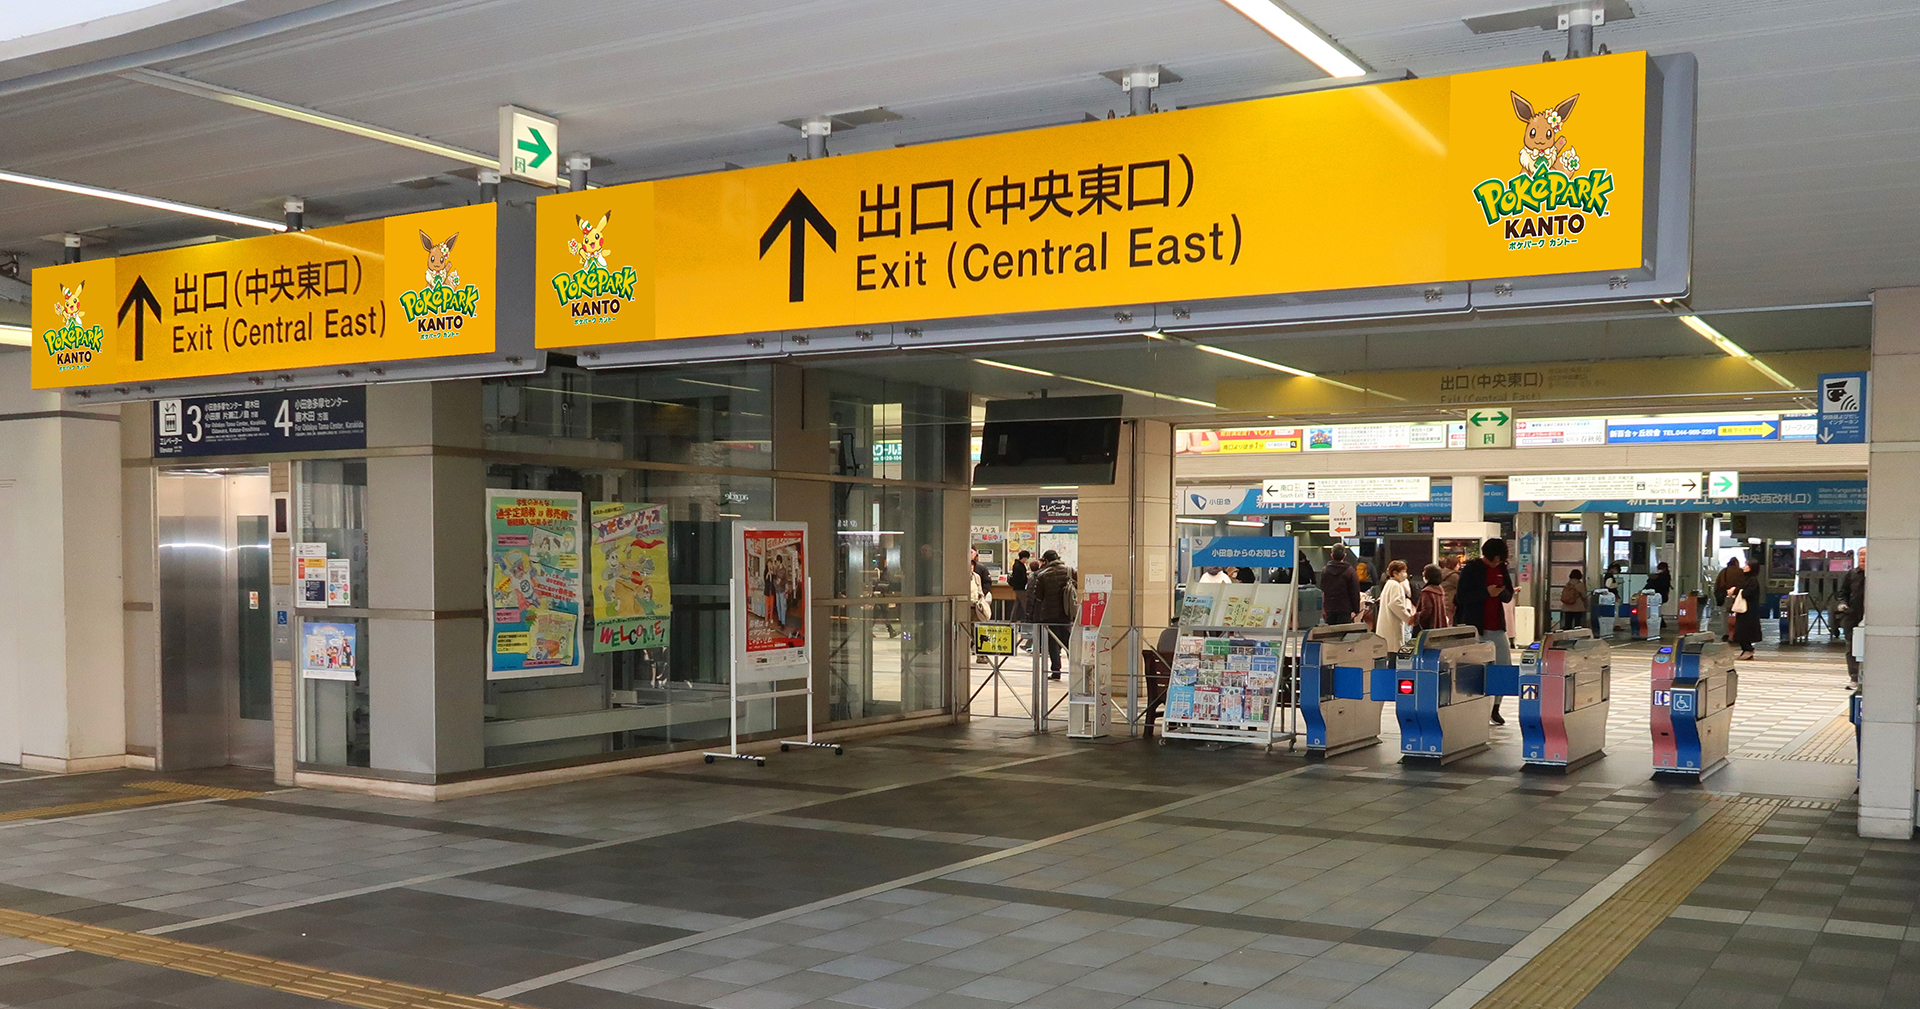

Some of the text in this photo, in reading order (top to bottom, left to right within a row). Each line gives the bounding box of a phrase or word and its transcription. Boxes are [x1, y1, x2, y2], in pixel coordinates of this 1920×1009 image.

[859, 153, 1194, 242] 出口(中央東口)
[1505, 213, 1585, 239] KANTO
[857, 214, 1242, 291] Exit (Central East)
[1508, 237, 1578, 250] ポケパーク カントー
[174, 255, 362, 316] 出口(中央東口)
[571, 299, 620, 317] KANTO
[174, 301, 386, 353] Exit (Central East)
[418, 315, 463, 333] KANTO
[57, 350, 92, 365] KANTO
[1441, 372, 1544, 391] 出口(中央東口)
[295, 397, 348, 410] 小田急多摩センター
[1441, 394, 1460, 403] Exit
[186, 405, 203, 443] 3
[274, 399, 293, 437] 4
[317, 412, 329, 421] 方面
[160, 438, 183, 446] エレベーター
[1666, 517, 1675, 528] 4
[1211, 548, 1286, 558] 小田急からのお知らせ
[600, 620, 665, 647] WELCOME!
